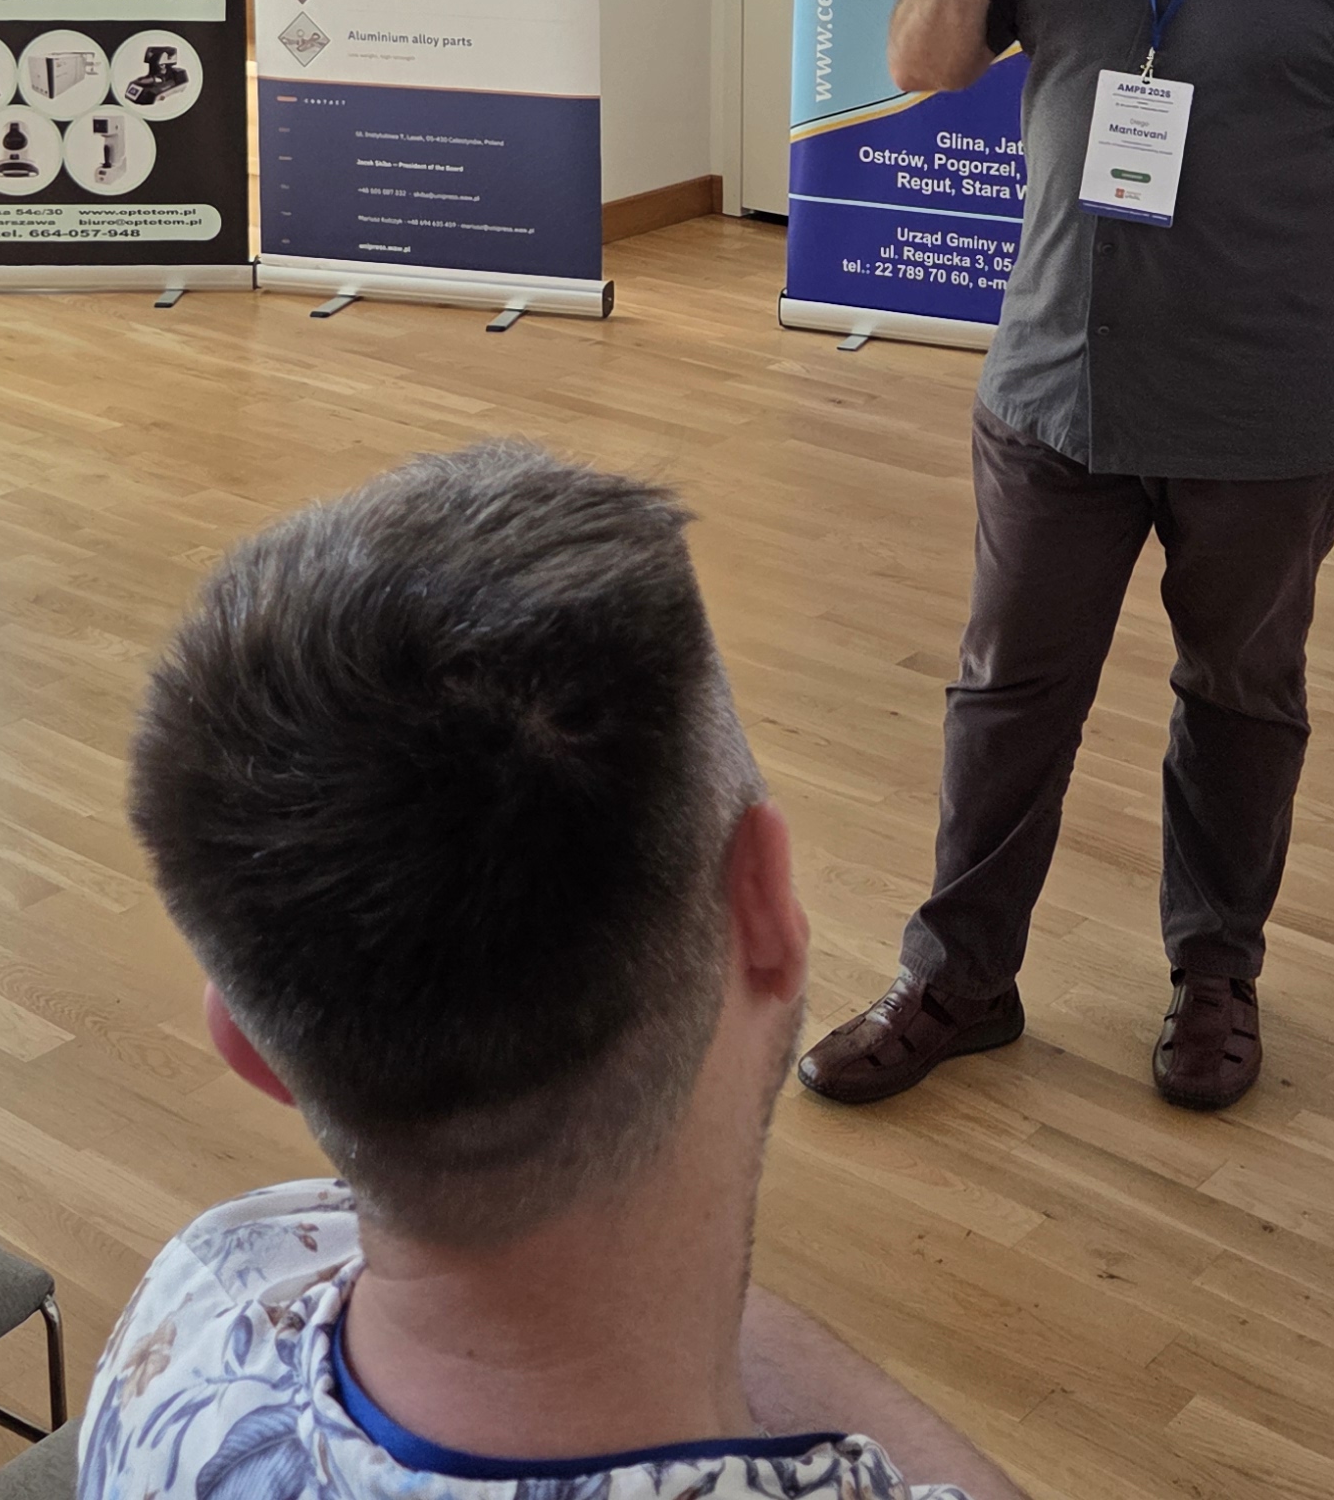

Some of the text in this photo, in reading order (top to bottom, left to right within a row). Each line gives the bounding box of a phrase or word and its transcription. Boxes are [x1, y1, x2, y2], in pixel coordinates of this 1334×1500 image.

[348, 30, 473, 48] Aluminium alloy parts
[1117, 83, 1147, 95] AMPB
[936, 131, 990, 155] Glina,
[1109, 124, 1168, 141] Mantovani
[859, 146, 1021, 180] Ostrów, Pogorzel,
[896, 171, 956, 196] Regut,
[961, 178, 1011, 199] Stara
[78, 208, 197, 218] www.optotom.pl
[78, 218, 203, 227] biuro@optotom.pl
[29, 229, 141, 238] 664-057-948
[896, 227, 1015, 255] Urząd Gminy w
[880, 245, 899, 259] ul.
[903, 246, 971, 267] Regucka
[975, 254, 989, 272] 3,
[842, 258, 871, 275] tel.:
[874, 262, 894, 277] 22
[897, 265, 924, 281] 789
[928, 268, 947, 283] 70
[950, 271, 973, 289] 60,
